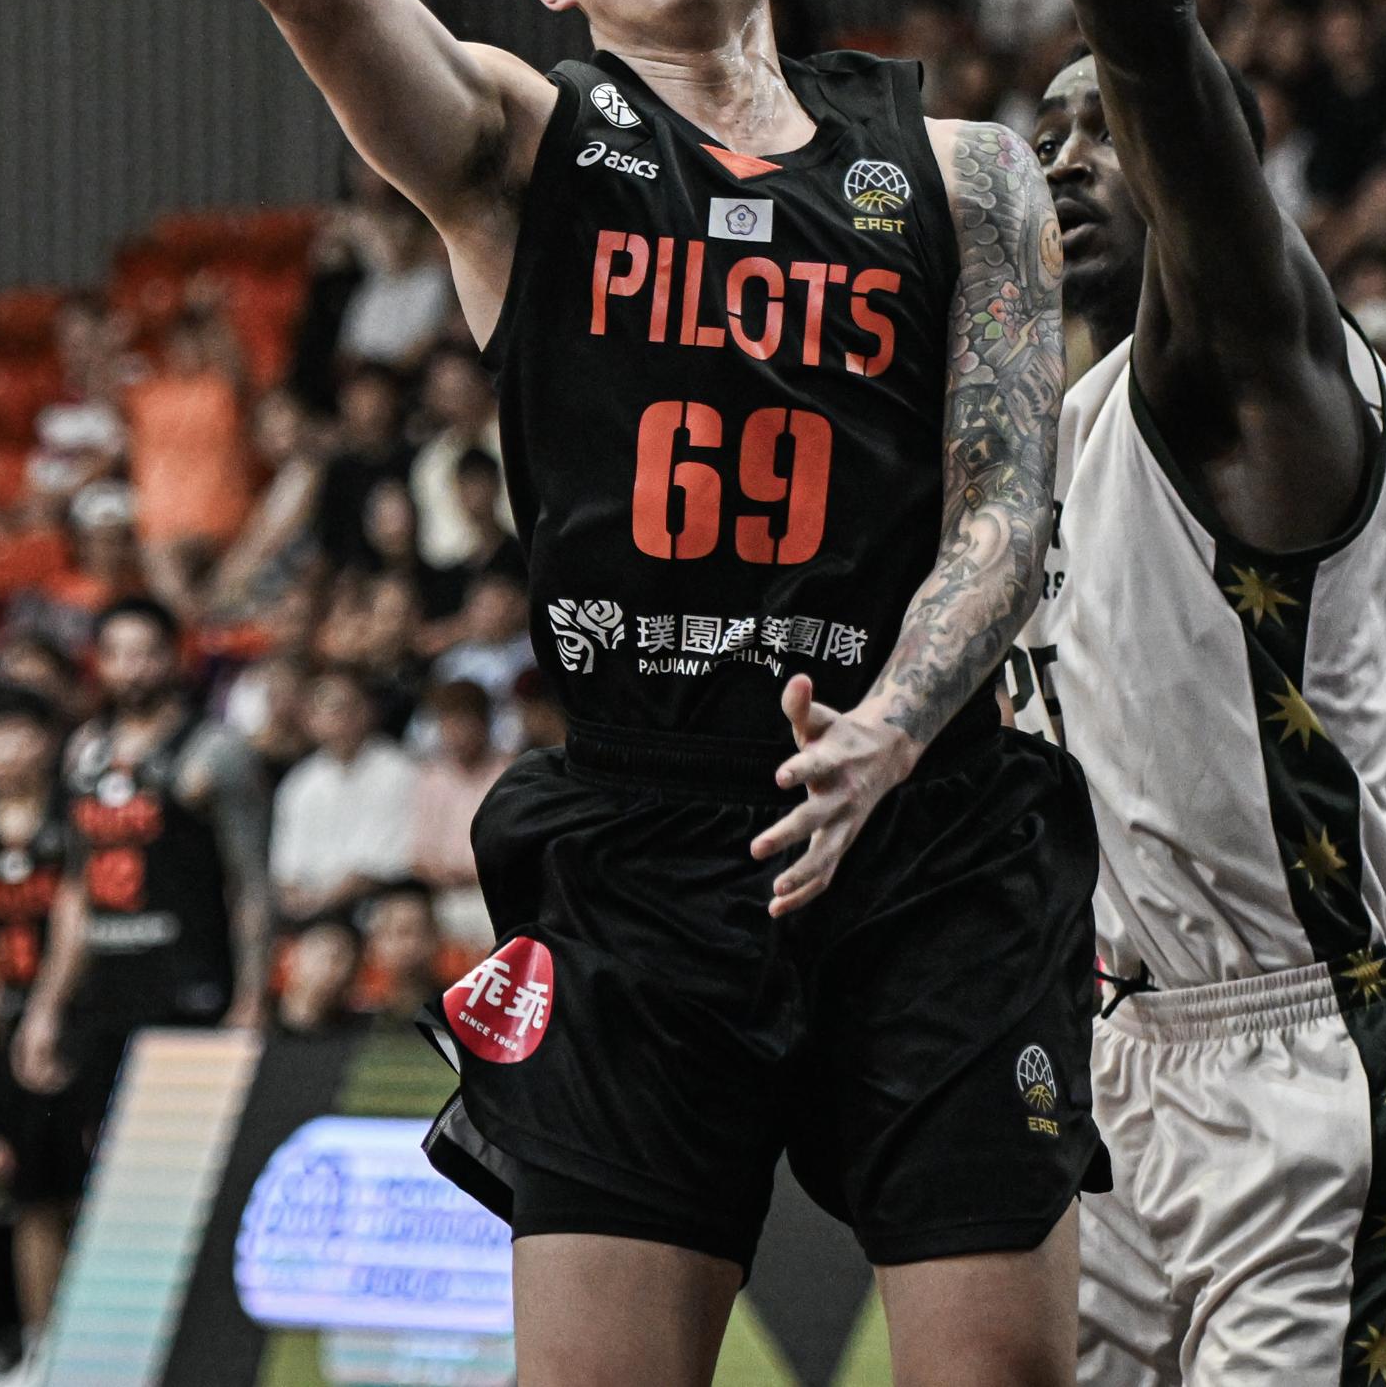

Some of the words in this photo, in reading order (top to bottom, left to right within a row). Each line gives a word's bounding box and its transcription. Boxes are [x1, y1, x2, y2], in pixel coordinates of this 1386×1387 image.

[604, 150, 660, 180] asics
[853, 216, 905, 234] EAST
[590, 230, 902, 378] PILOTS
[632, 400, 834, 565] 69
[638, 658, 700, 676] PAUIAN
[458, 1011, 491, 1037] SINCE
[1027, 1116, 1060, 1138] EAST
